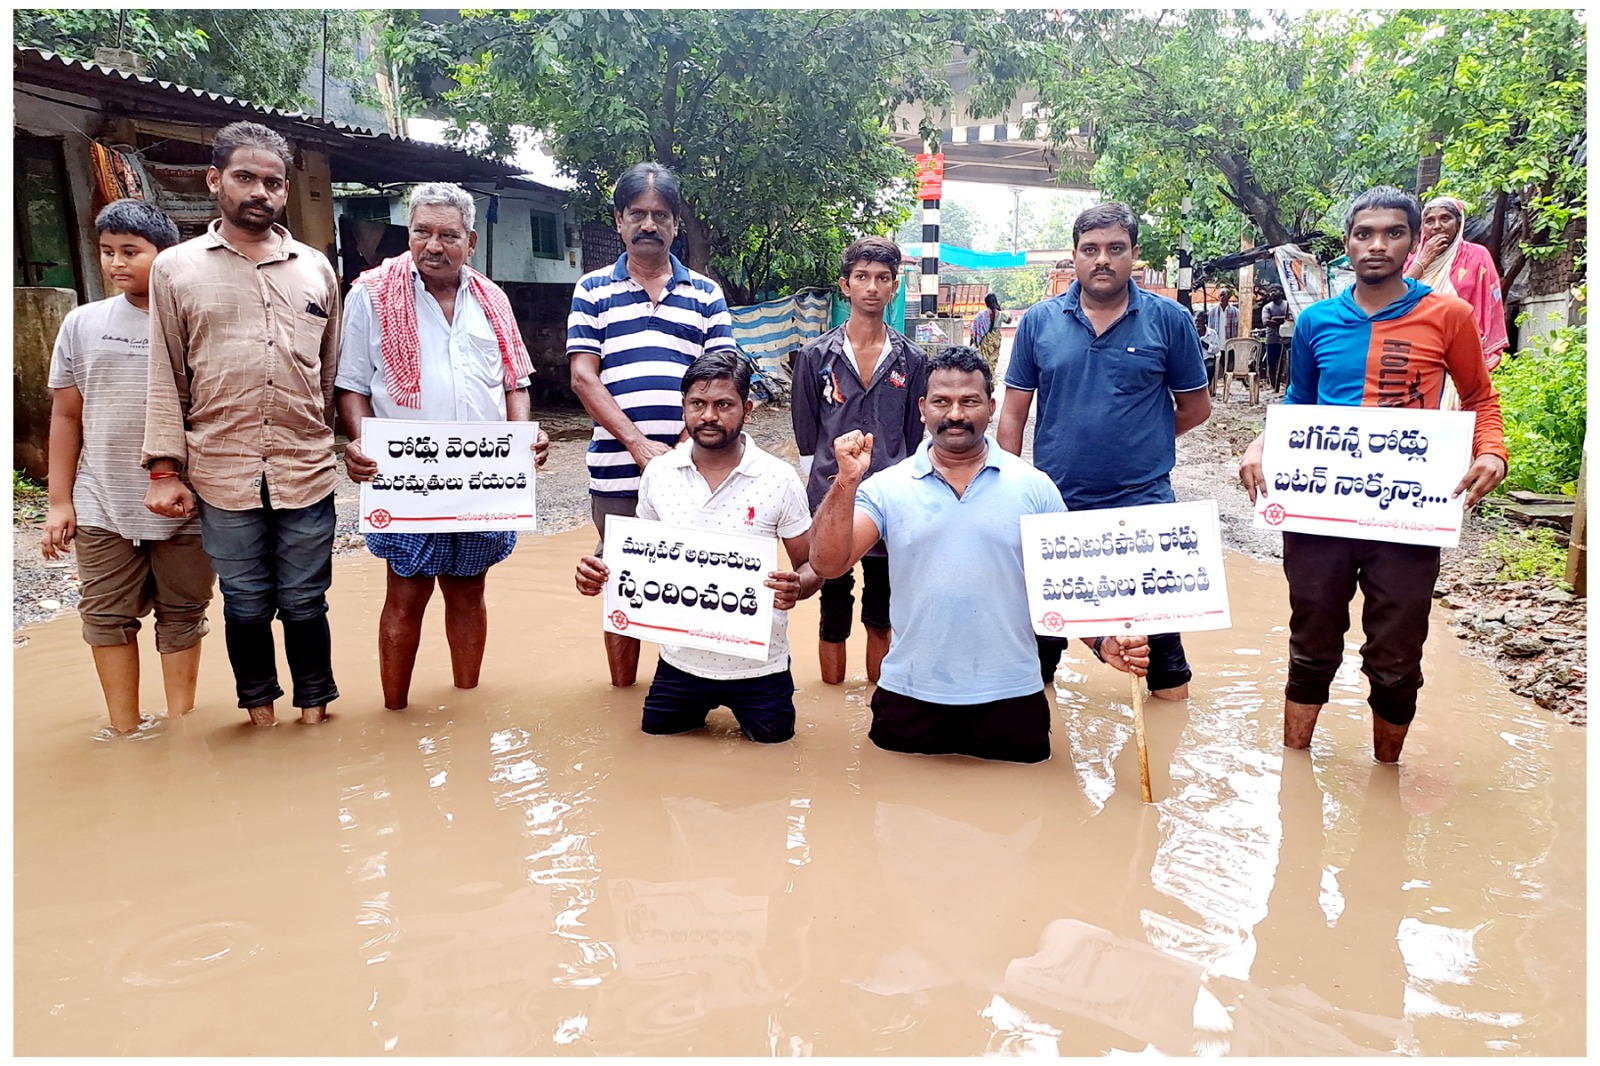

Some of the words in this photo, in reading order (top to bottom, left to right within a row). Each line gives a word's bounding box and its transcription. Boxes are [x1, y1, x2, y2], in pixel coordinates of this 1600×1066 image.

[388, 436, 439, 463] రోడ్లు
[446, 434, 513, 458] వెంటనే
[1289, 426, 1362, 458] జగనన్న
[1369, 430, 1428, 462] రోడ్లు
[372, 474, 463, 496] మరమ్మతులు
[468, 472, 527, 490] చేయండి
[1275, 467, 1328, 493] బటన్
[622, 537, 683, 563] మున్సిపల్
[685, 550, 761, 572] అధికారులు
[1158, 526, 1199, 555] రోడ్లు
[618, 570, 758, 616] స్పందించండి
[1043, 575, 1136, 606] మరమ్మతులు
[1141, 567, 1210, 595] చేయండి
